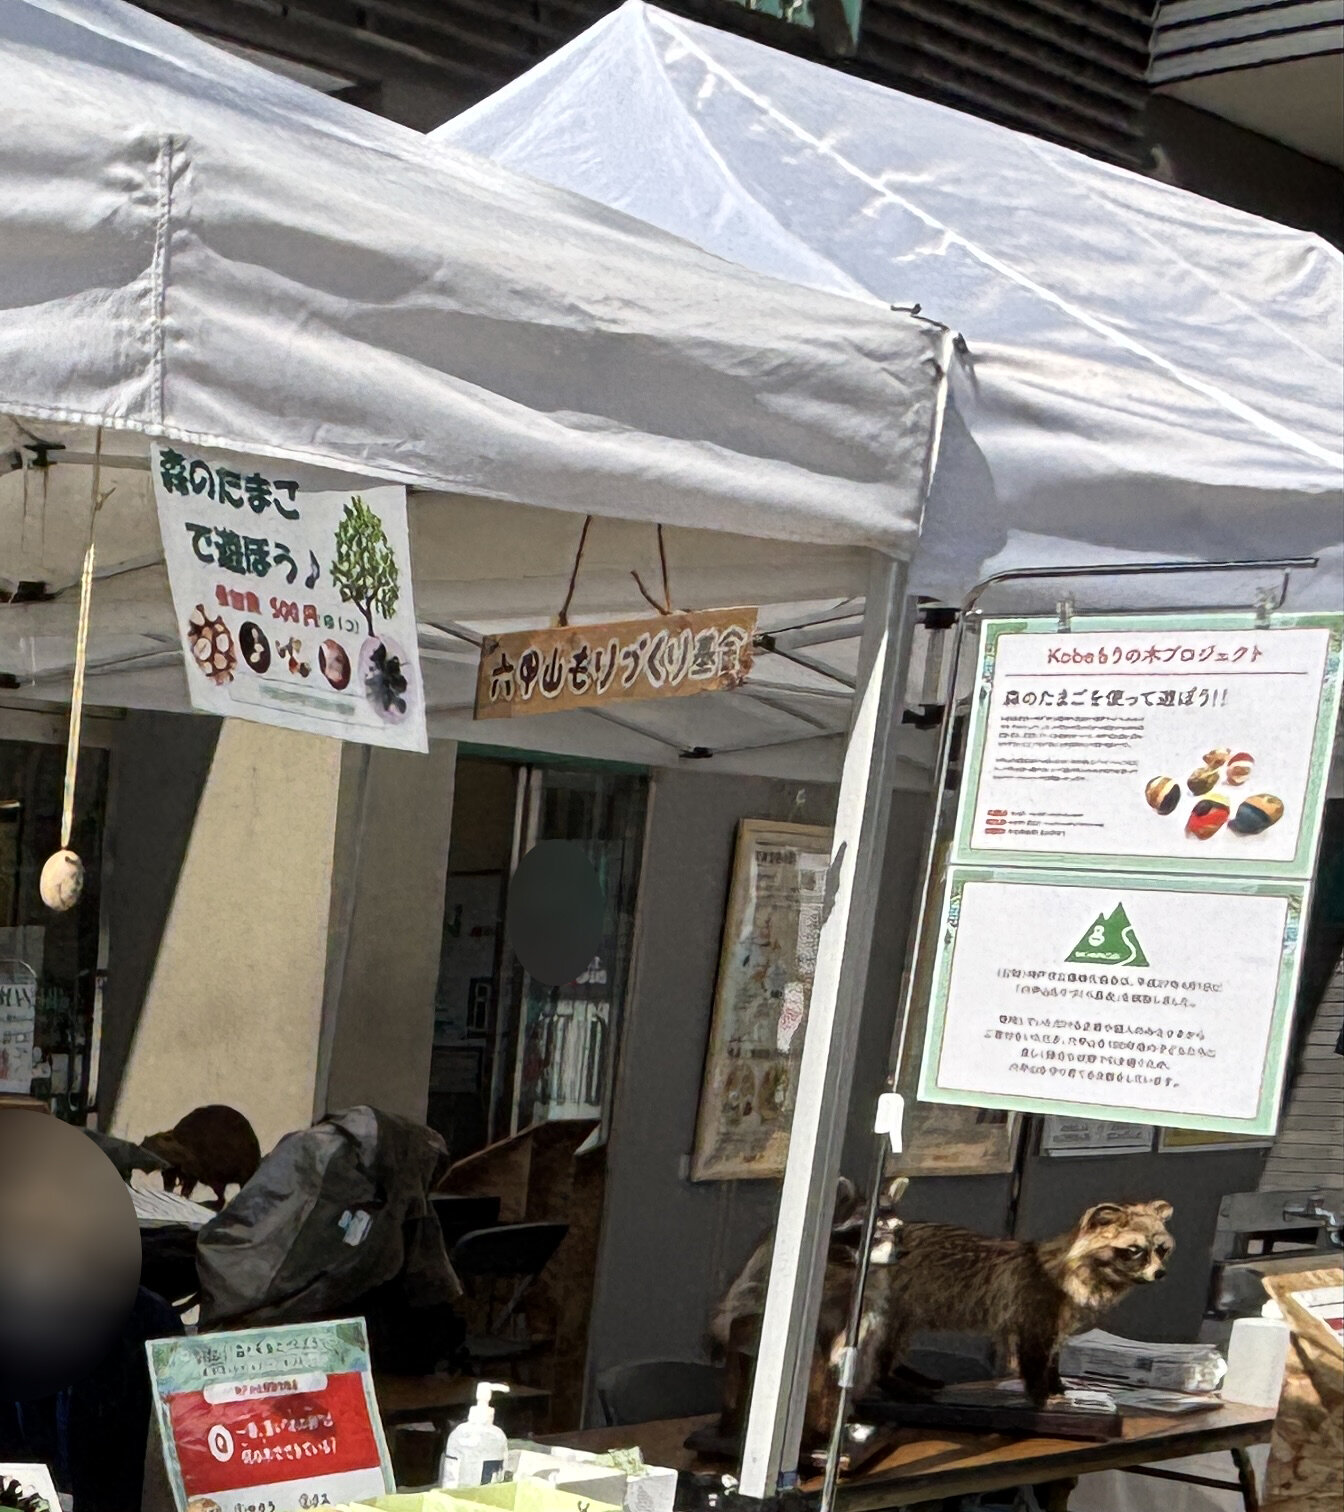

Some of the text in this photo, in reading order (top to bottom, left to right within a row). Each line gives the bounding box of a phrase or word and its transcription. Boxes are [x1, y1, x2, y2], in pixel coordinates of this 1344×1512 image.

[160, 446, 300, 520] 森のたまご
